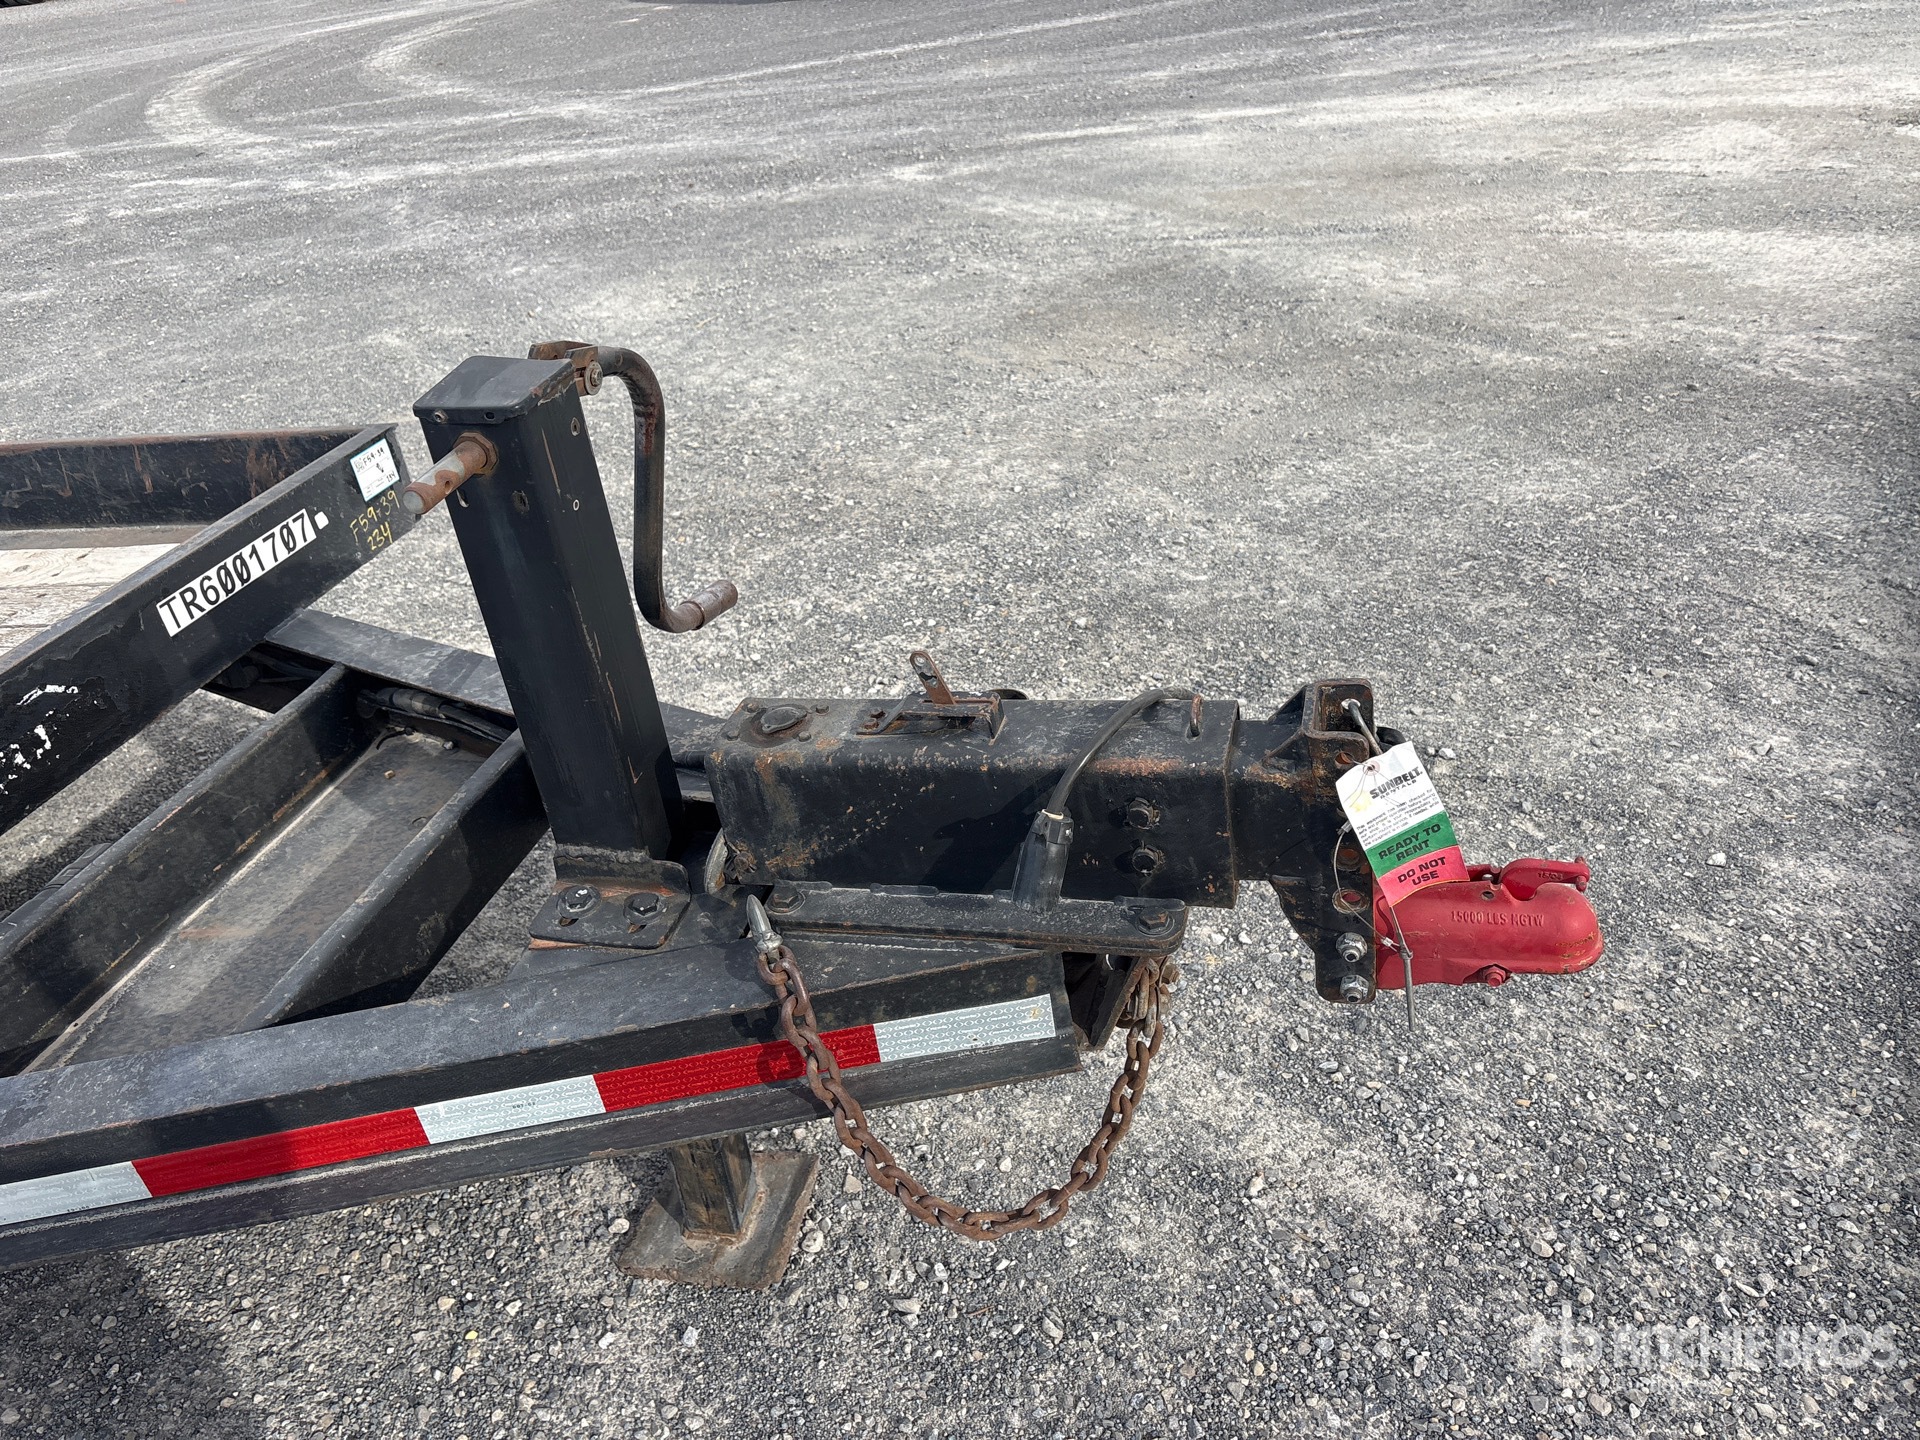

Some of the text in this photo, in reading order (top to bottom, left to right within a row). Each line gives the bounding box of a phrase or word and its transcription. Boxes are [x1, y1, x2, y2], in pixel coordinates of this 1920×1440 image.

[367, 521, 393, 551] 234
[158, 512, 308, 629] TR6001707
[1380, 779, 1417, 800] RENTALS
[1378, 823, 1441, 860] READY TO
[1395, 839, 1430, 862] RENT
[1397, 857, 1446, 884] DO NOT
[1411, 870, 1440, 886] USE
[1450, 910, 1484, 925] 15000
